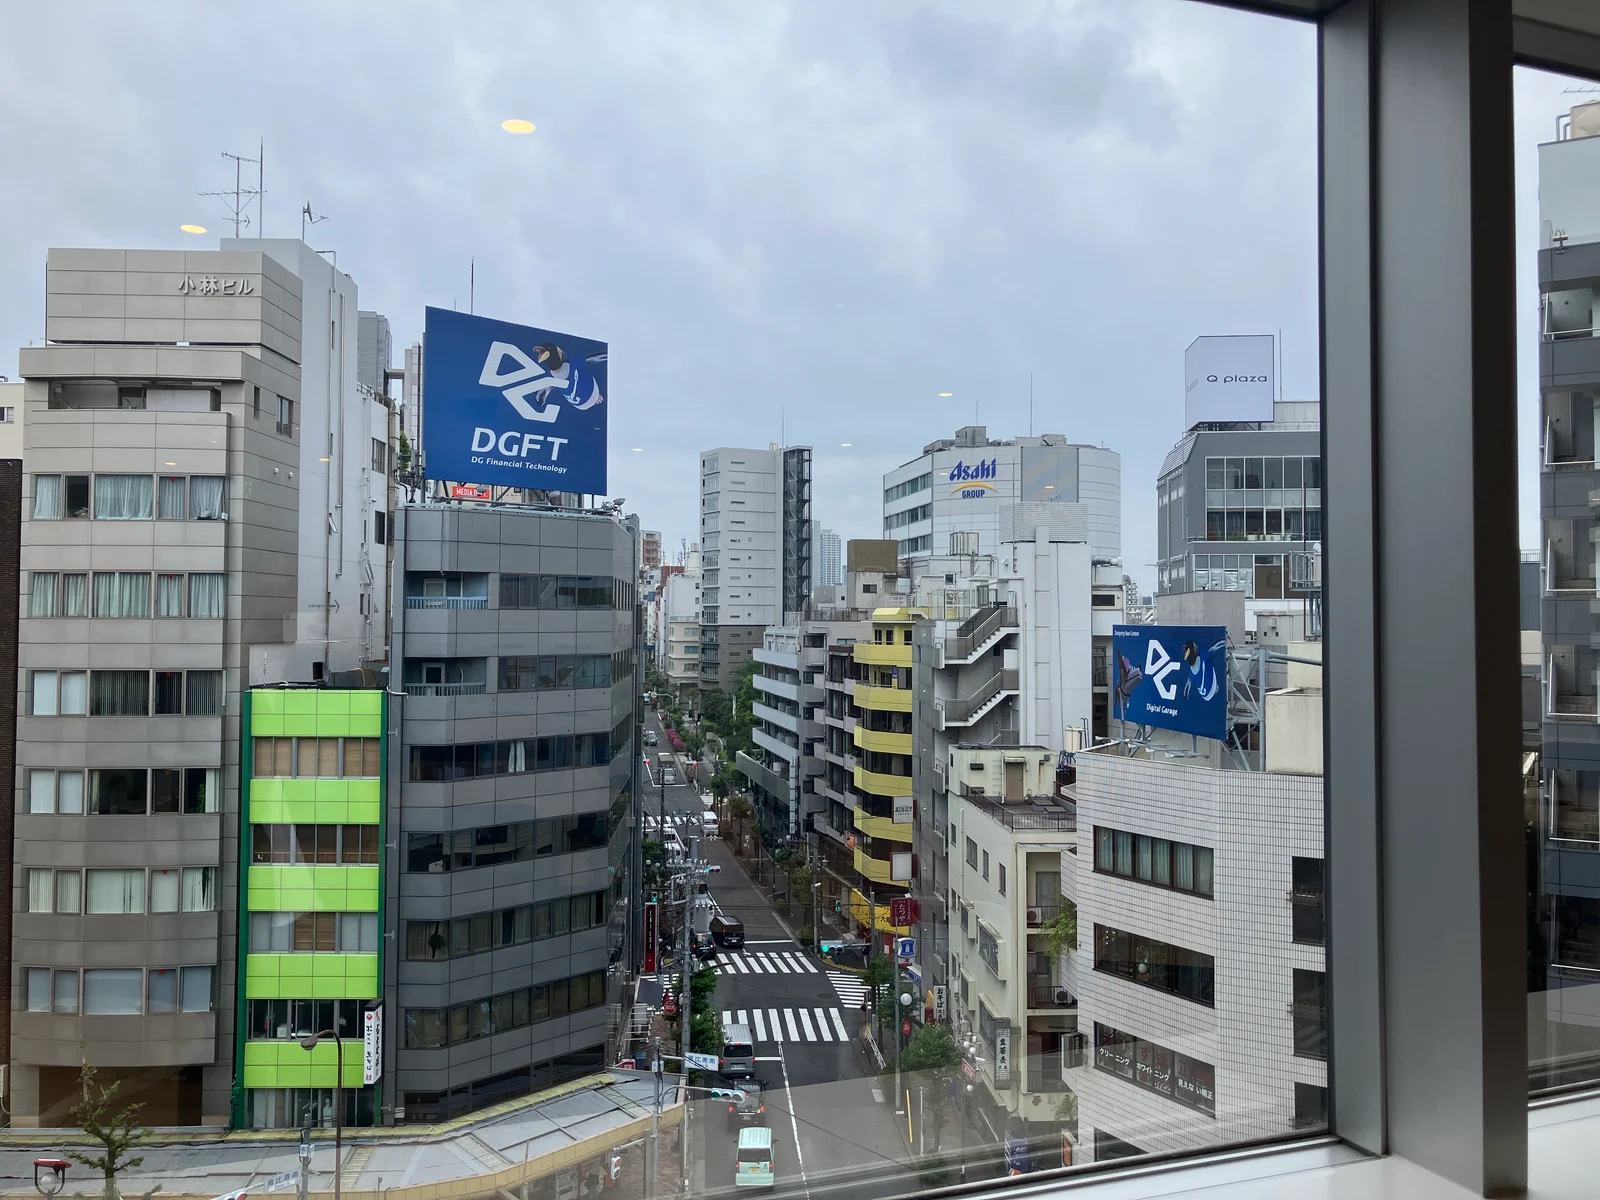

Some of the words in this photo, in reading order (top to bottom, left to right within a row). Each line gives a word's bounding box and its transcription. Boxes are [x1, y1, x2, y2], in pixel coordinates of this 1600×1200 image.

[178, 275, 253, 296] 小林ビル
[1206, 375, 1218, 383] Q
[1223, 375, 1268, 384] plaza
[471, 427, 569, 461] DGFT
[471, 456, 484, 464] DG
[486, 457, 523, 468] Financial
[525, 462, 568, 474] Technology
[950, 458, 997, 481] Asahi
[456, 488, 473, 497] MEDIA
[962, 489, 986, 499] GROUP
[1146, 702, 1161, 713] Digital
[1161, 705, 1178, 717] Garage
[936, 988, 945, 1008] おそば
